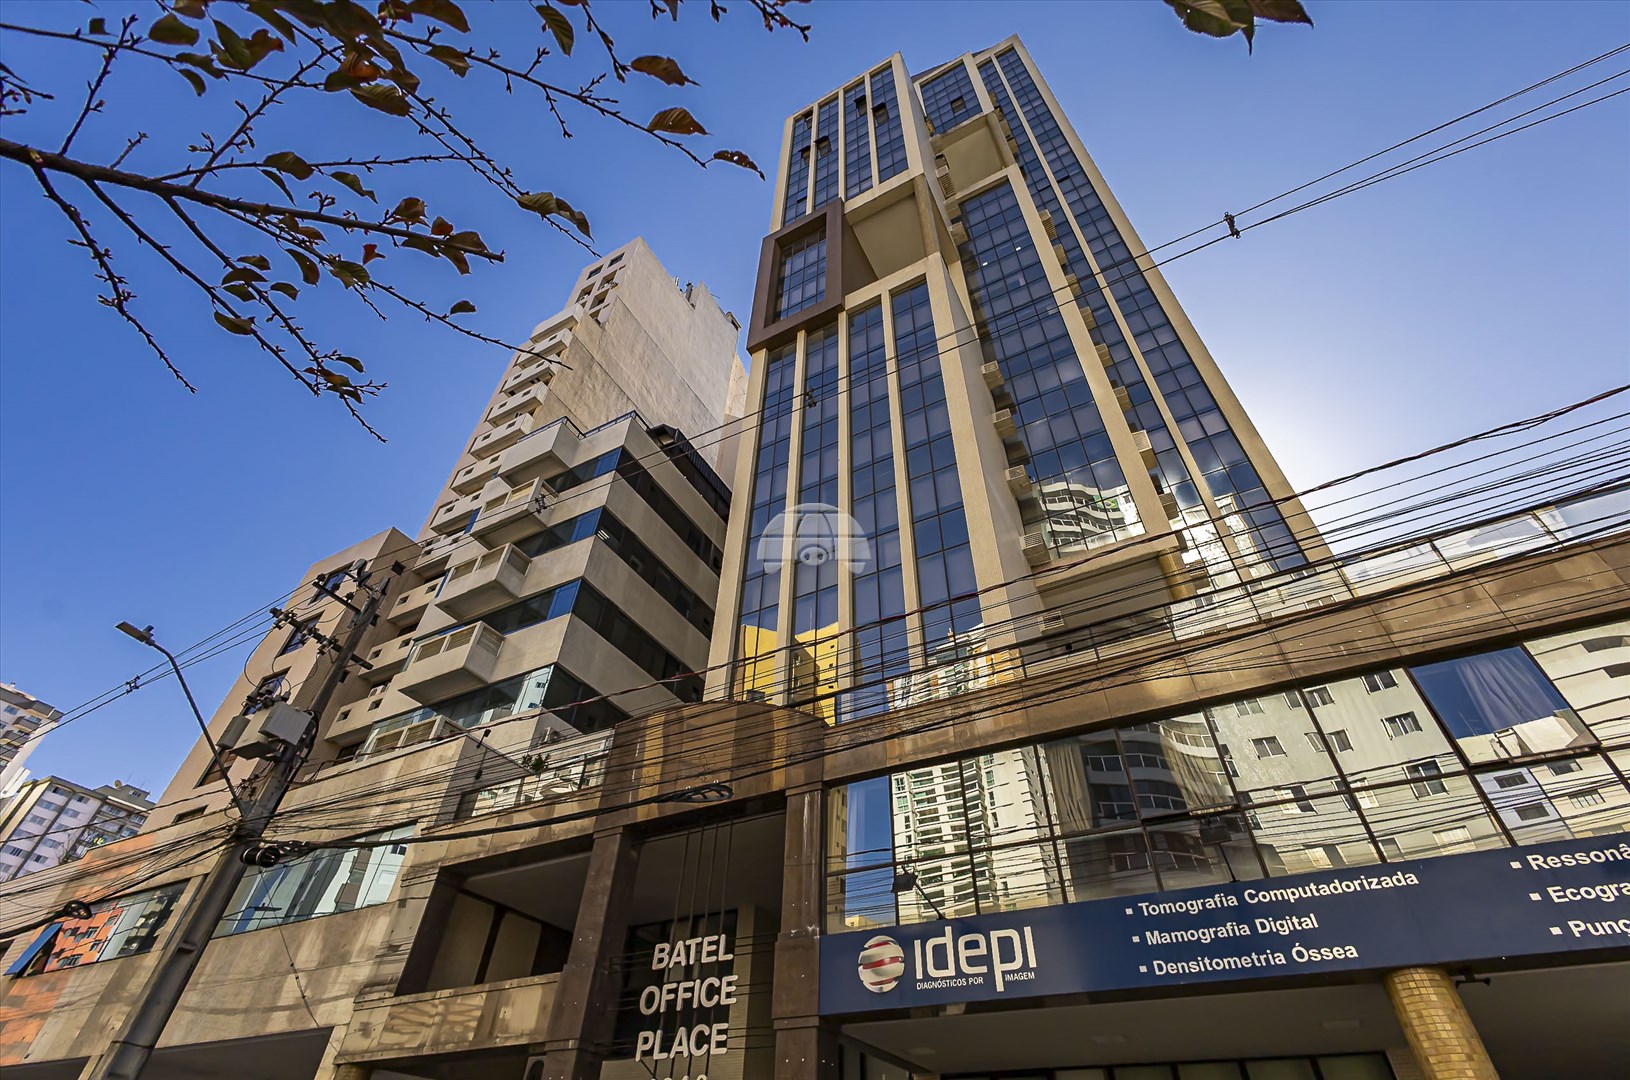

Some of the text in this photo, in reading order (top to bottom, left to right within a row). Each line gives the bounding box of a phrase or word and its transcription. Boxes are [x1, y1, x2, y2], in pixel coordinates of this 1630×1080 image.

[1138, 871, 1419, 915] Tomografia Computadorizada
[1145, 913, 1319, 946] Mamografia Digital
[651, 933, 734, 971] BATEL
[1152, 943, 1359, 976] Densitometria Óssea
[639, 974, 739, 1015] OFFICE
[916, 971, 1035, 990] DIAGNÓSTICOS POR IMAGEM
[635, 1022, 729, 1062] PLACE
